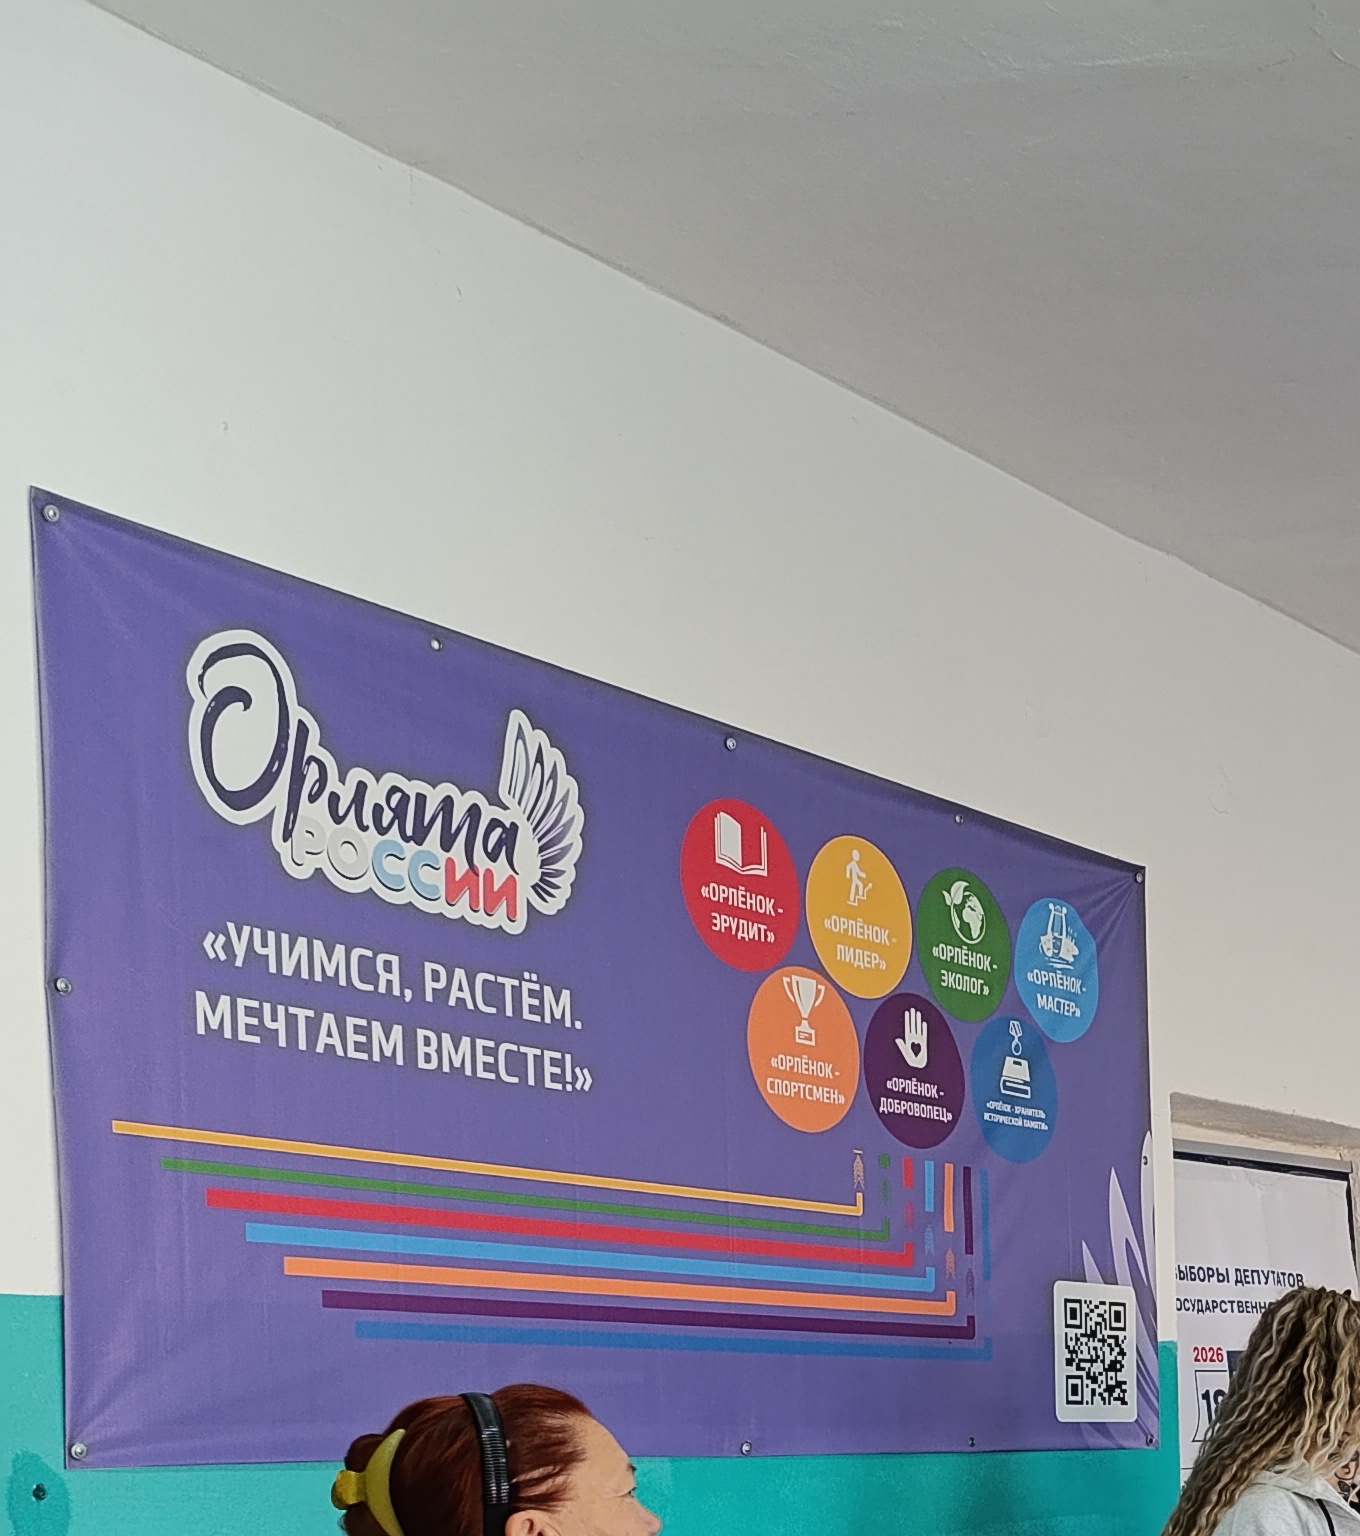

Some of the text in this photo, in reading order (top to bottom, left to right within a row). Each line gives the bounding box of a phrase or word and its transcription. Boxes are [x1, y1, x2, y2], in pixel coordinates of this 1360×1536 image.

[197, 642, 519, 874] Орлята
[711, 912, 775, 944] ЭРУДИТ»
[836, 943, 887, 971] ЛИДЕР»
[202, 921, 583, 1031] «УЧИМСЯ, РАСТЁМ.
[940, 969, 990, 997] ЭКОЛОГ»
[1036, 993, 1081, 1019] МАСТЕР»
[195, 989, 593, 1092] МЕЧТАЕМ ВМЕСТЕ!»
[766, 1077, 846, 1105] СПОРТСМЕН»
[879, 1096, 953, 1123] ДОБРОВОЛЕЦ»
[1174, 1264, 1231, 1284] ЫБОРЫ
[1193, 1346, 1224, 1363] 2026
